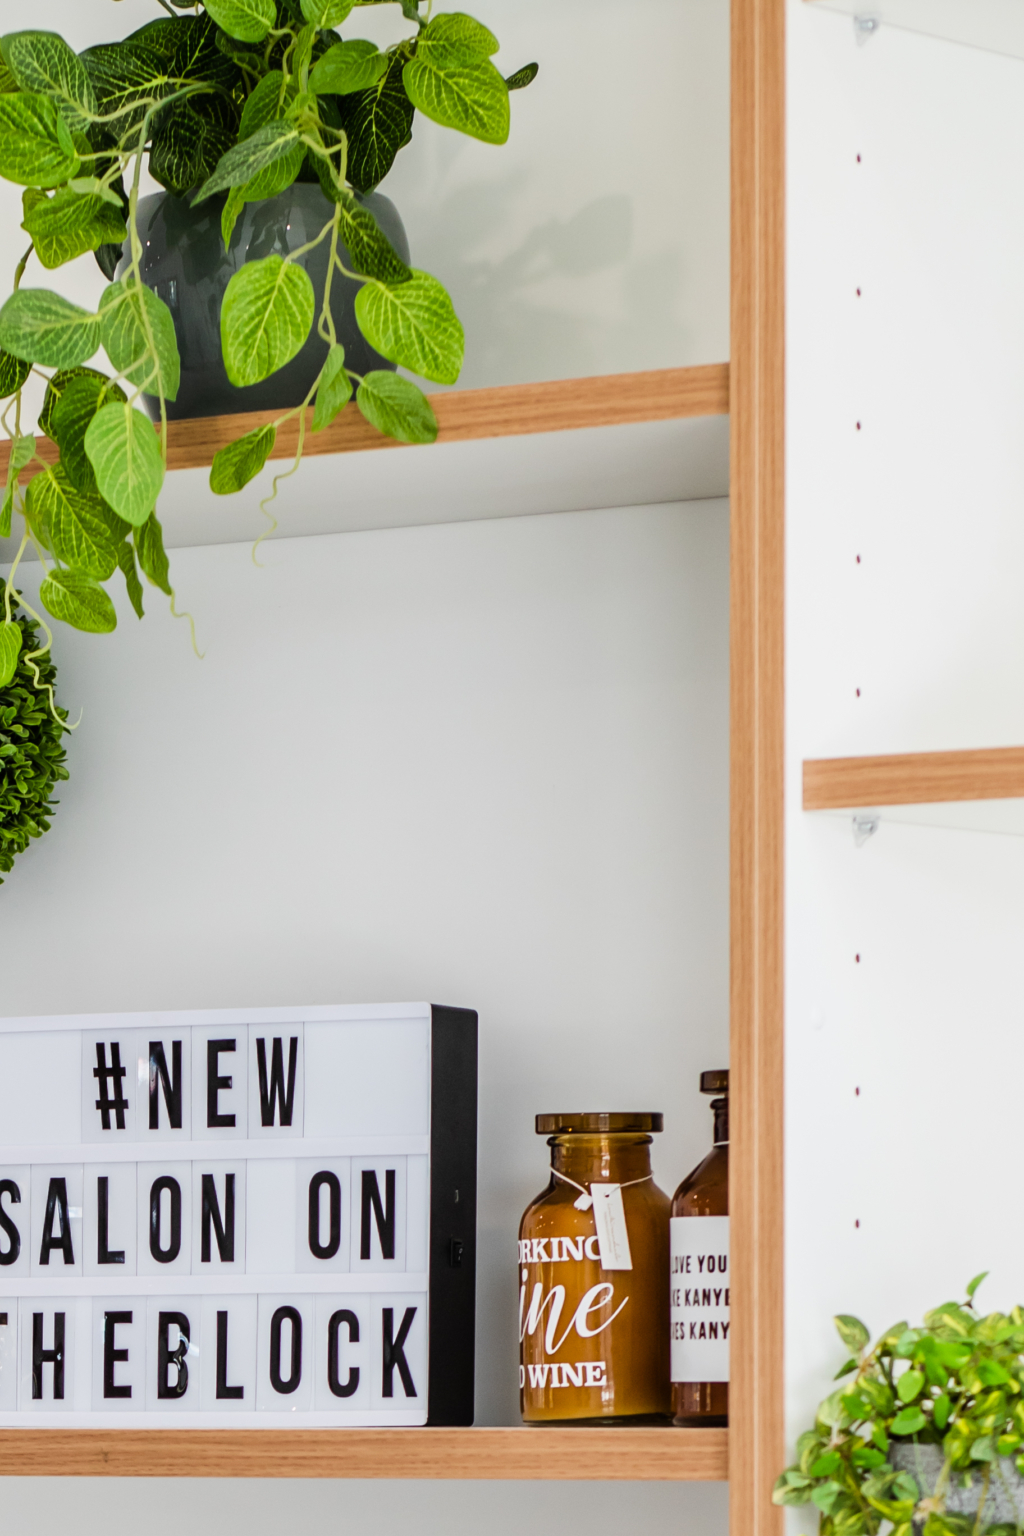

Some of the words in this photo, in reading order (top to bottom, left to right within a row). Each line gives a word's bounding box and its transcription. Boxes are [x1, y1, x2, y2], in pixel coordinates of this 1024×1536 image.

[92, 1036, 298, 1130] #NEW
[308, 1169, 396, 1260] ON
[698, 1255, 727, 1273] YOU
[528, 1361, 607, 1388] WINE
